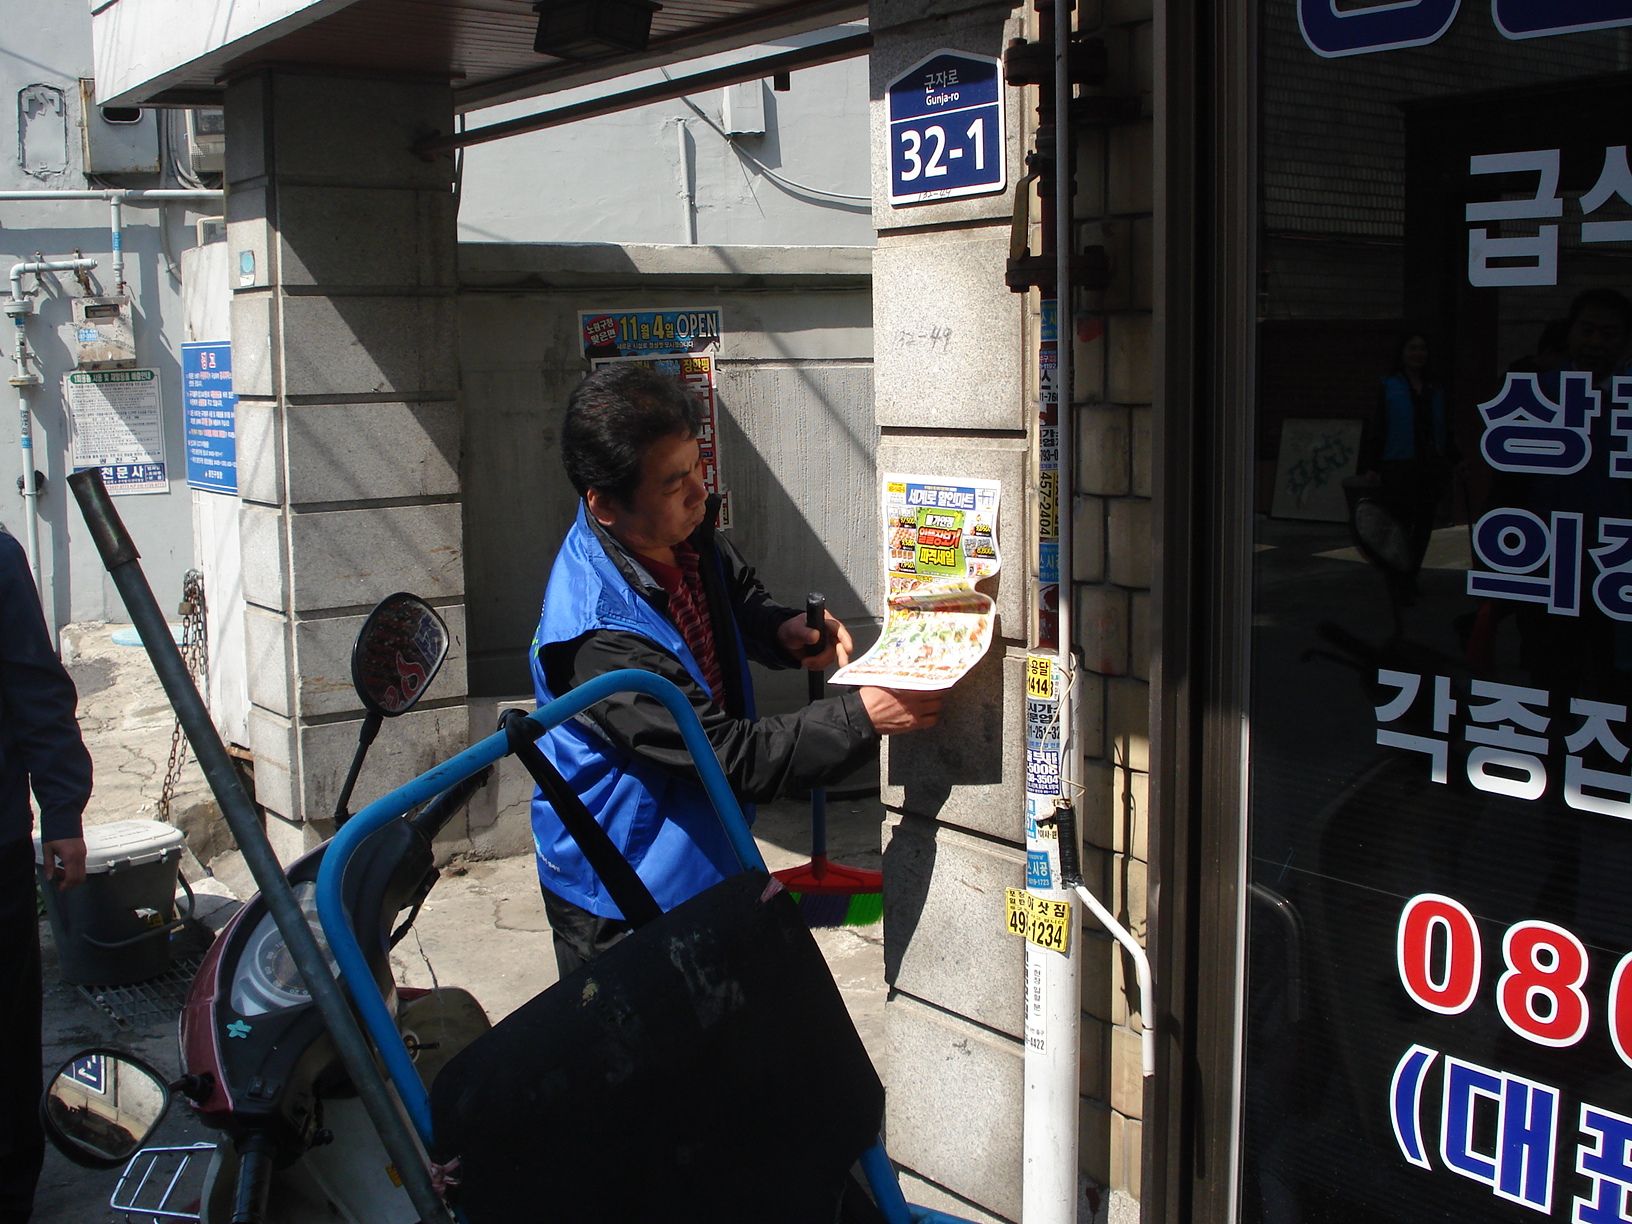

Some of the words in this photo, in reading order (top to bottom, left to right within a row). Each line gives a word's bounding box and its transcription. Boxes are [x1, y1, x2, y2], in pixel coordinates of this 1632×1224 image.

[924, 69, 959, 94] 군자로
[925, 91, 960, 106] Gunja-ro
[900, 117, 984, 182] 32-1
[676, 312, 718, 338] OPEN
[1477, 370, 1632, 479] 상
[938, 490, 975, 508] 할인마트
[1040, 471, 1052, 536] 457-2404
[920, 547, 955, 566] 파격세일
[1031, 659, 1049, 677] 용달
[1397, 892, 1632, 1071] 08
